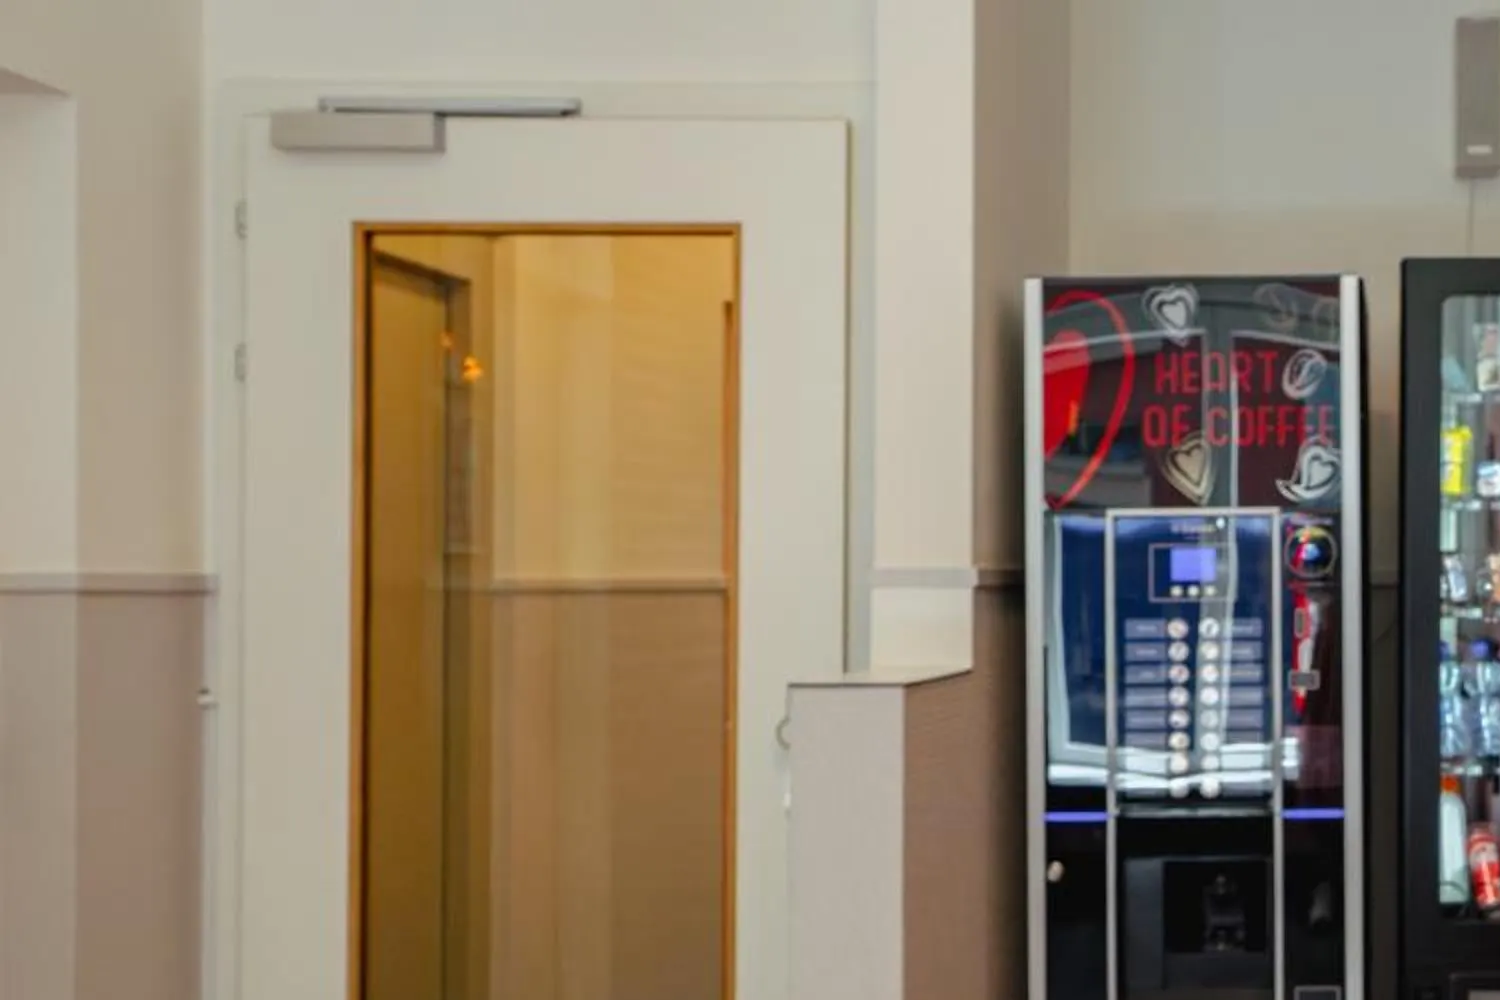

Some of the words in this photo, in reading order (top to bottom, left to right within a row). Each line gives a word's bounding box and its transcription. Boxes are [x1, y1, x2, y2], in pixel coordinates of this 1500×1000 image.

[1155, 351, 1278, 394] HEART
[1143, 404, 1191, 447] OF
[1207, 405, 1336, 446] COFFEE
